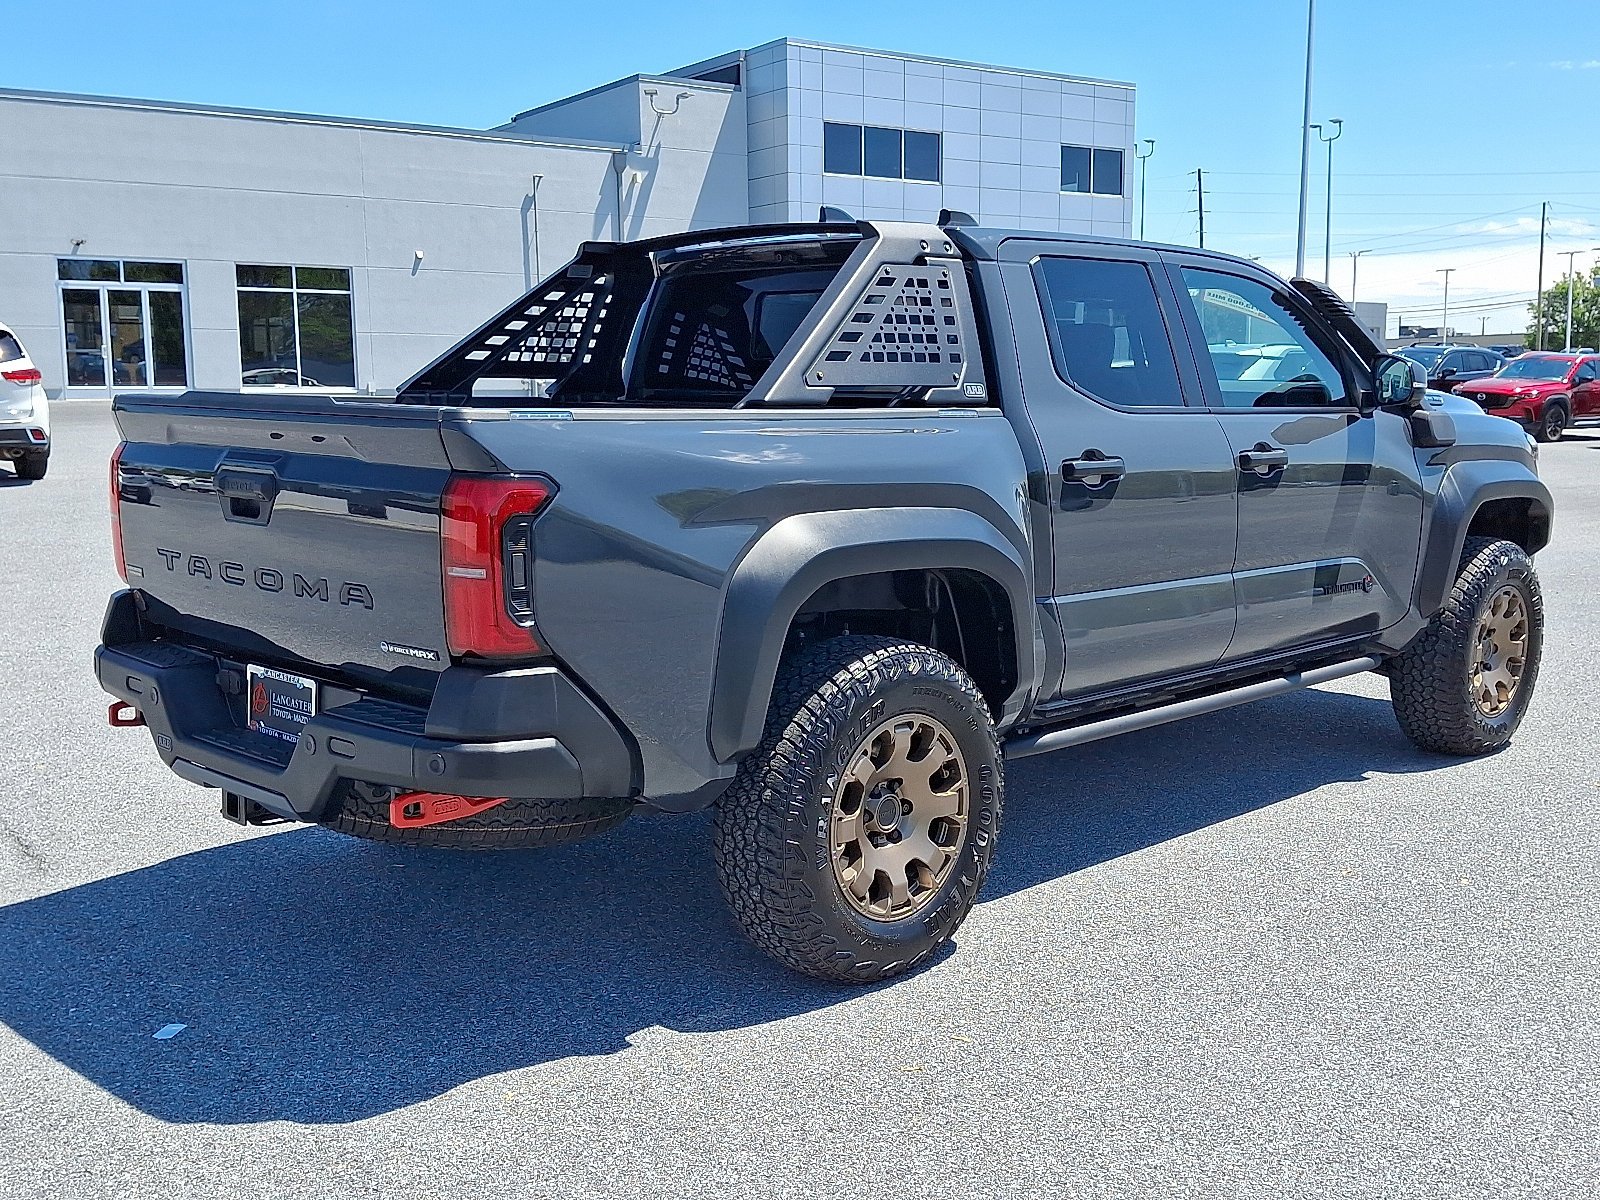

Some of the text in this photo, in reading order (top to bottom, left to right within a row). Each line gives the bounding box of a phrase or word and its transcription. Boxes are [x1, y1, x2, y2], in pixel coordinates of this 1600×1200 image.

[966, 385, 984, 395] ARB
[157, 547, 375, 610] TACOMA
[410, 649, 436, 660] MAX
[272, 692, 313, 713] LANCASTER
[921, 764, 993, 937] GOODYEAR
